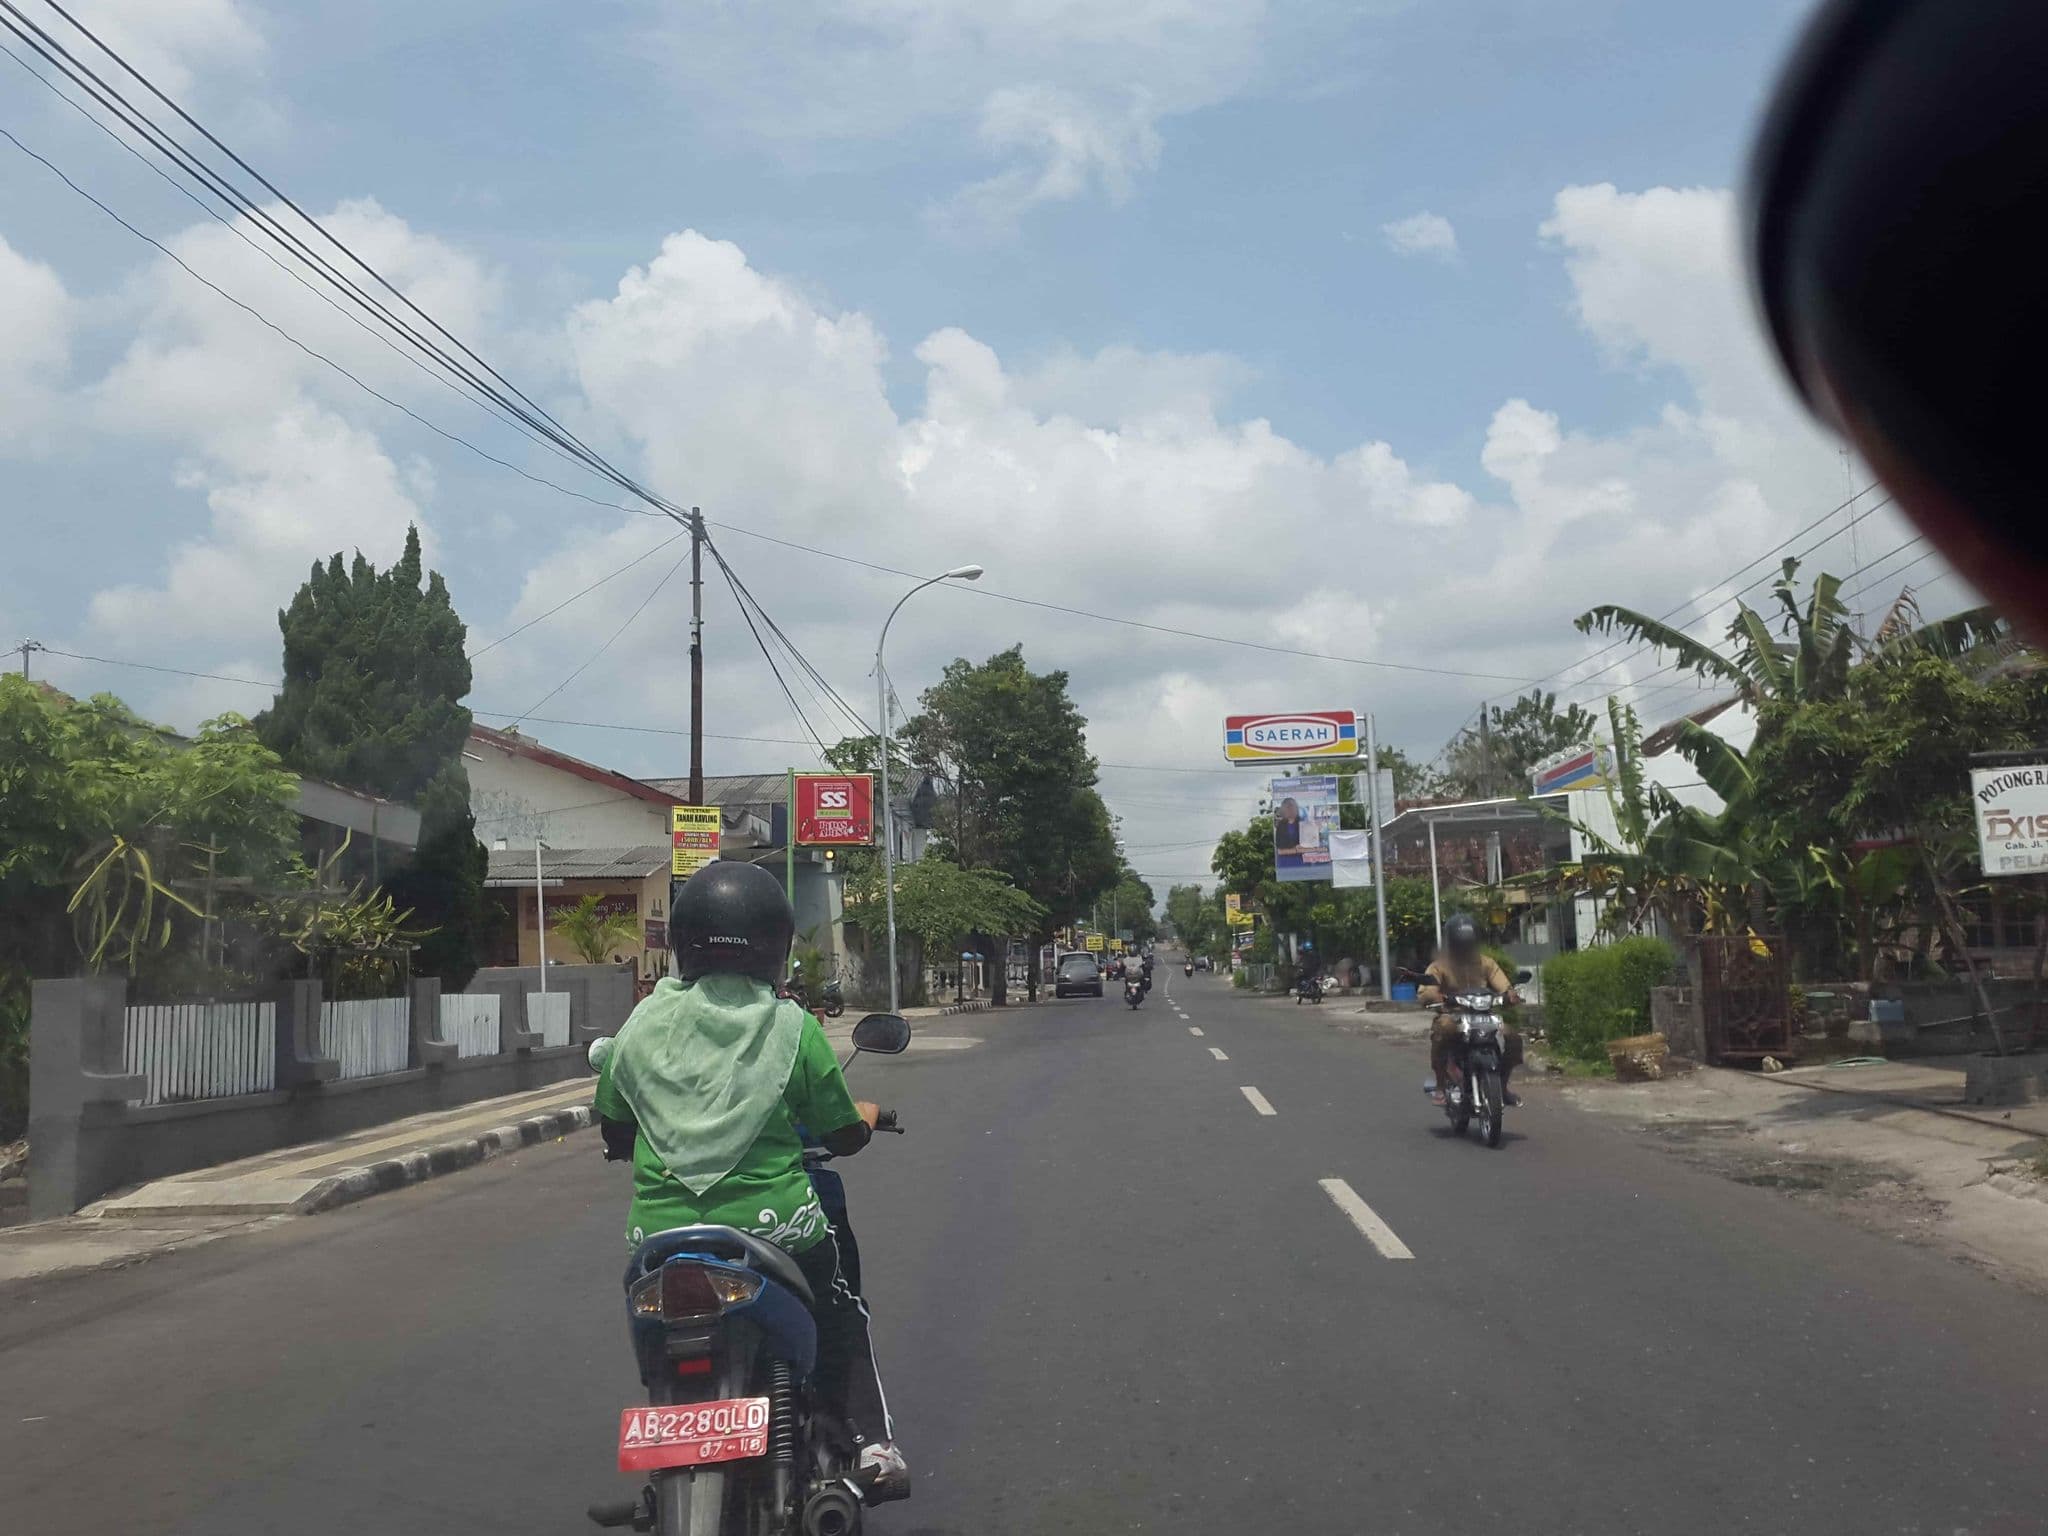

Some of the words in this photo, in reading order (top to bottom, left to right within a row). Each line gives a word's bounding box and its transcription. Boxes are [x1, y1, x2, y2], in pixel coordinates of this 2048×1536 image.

[1255, 728, 1327, 741] SAERAH
[1978, 771, 2033, 804] POTONG
[821, 791, 847, 808] SS
[676, 814, 694, 823] TANAH
[694, 815, 718, 823] KAVLING
[709, 936, 749, 945] HONDA
